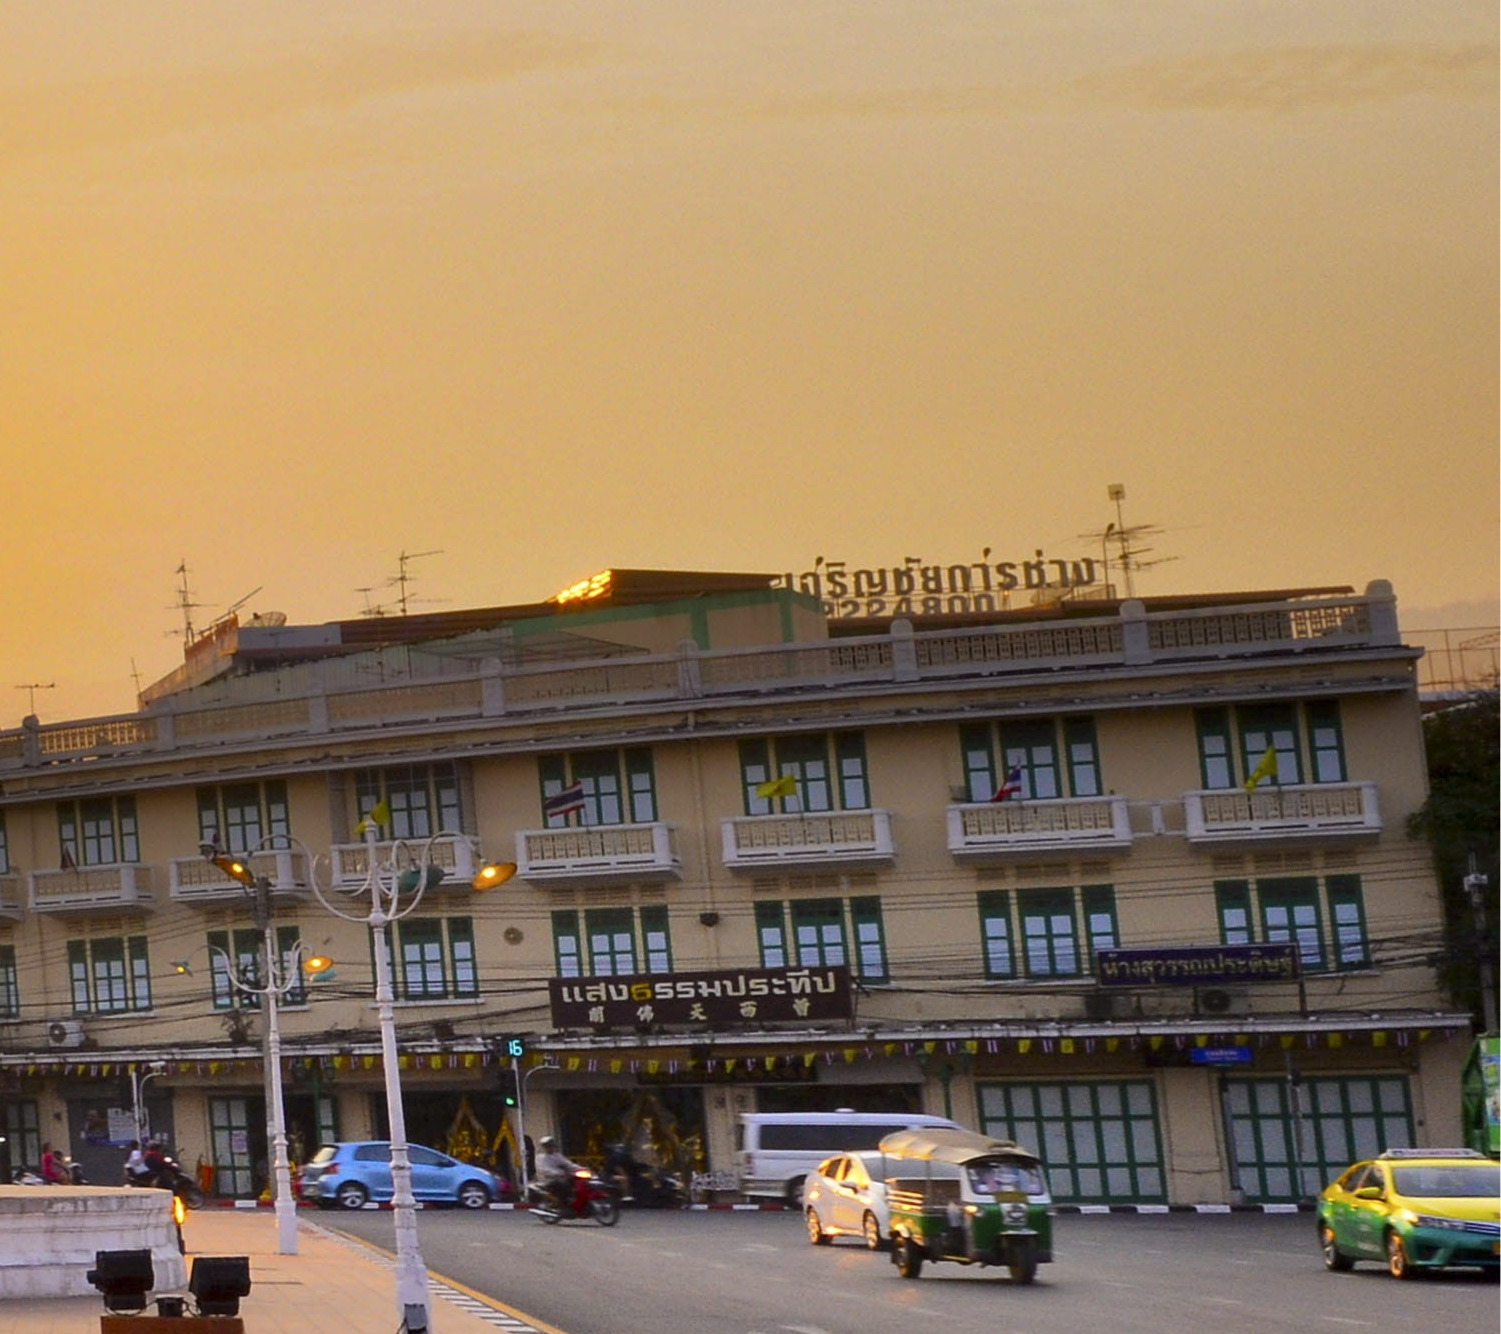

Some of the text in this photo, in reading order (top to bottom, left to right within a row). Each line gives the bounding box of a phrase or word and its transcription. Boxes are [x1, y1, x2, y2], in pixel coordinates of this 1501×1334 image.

[561, 969, 836, 1002] แสงธรรมประทีป
[508, 1039, 523, 1057] 16
